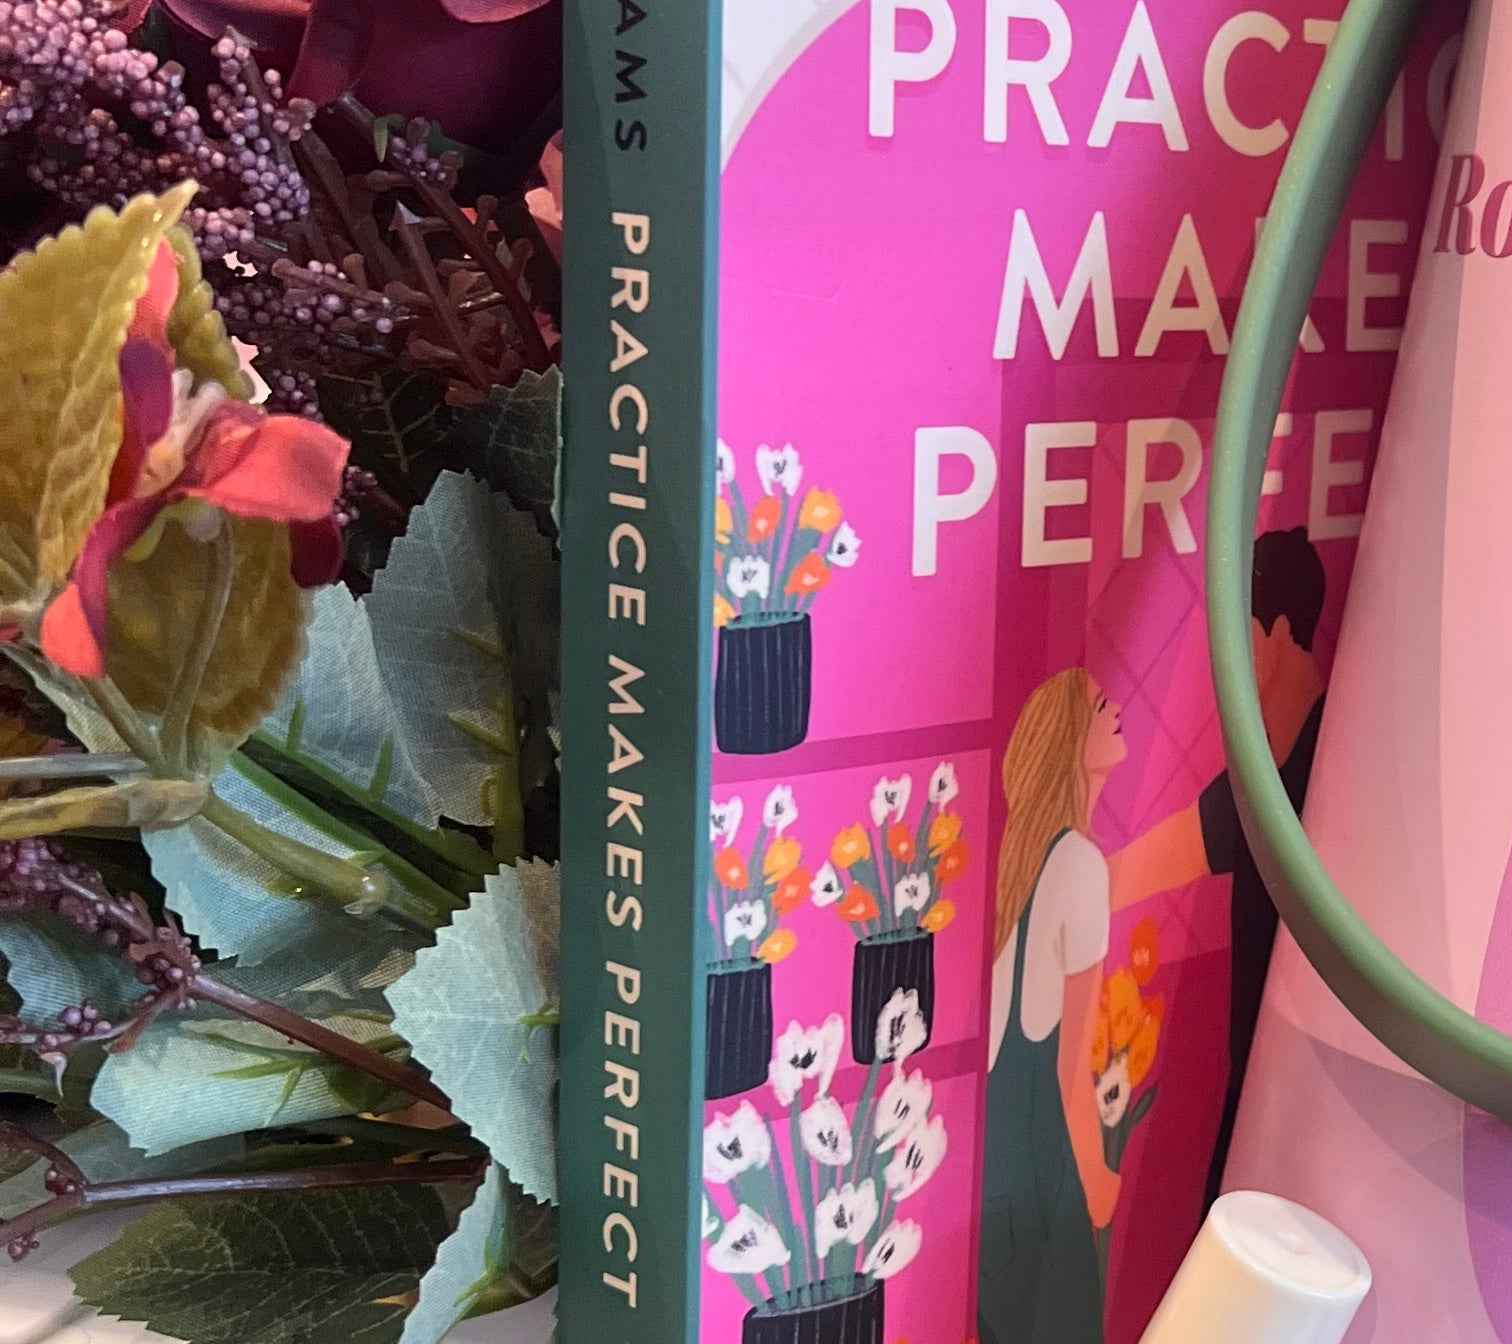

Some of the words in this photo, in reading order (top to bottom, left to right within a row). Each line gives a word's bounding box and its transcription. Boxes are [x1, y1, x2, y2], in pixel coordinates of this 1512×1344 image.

[608, 211, 651, 626] PRACTICE
[605, 653, 645, 933] MAKES
[602, 960, 641, 1308] PERFECT
